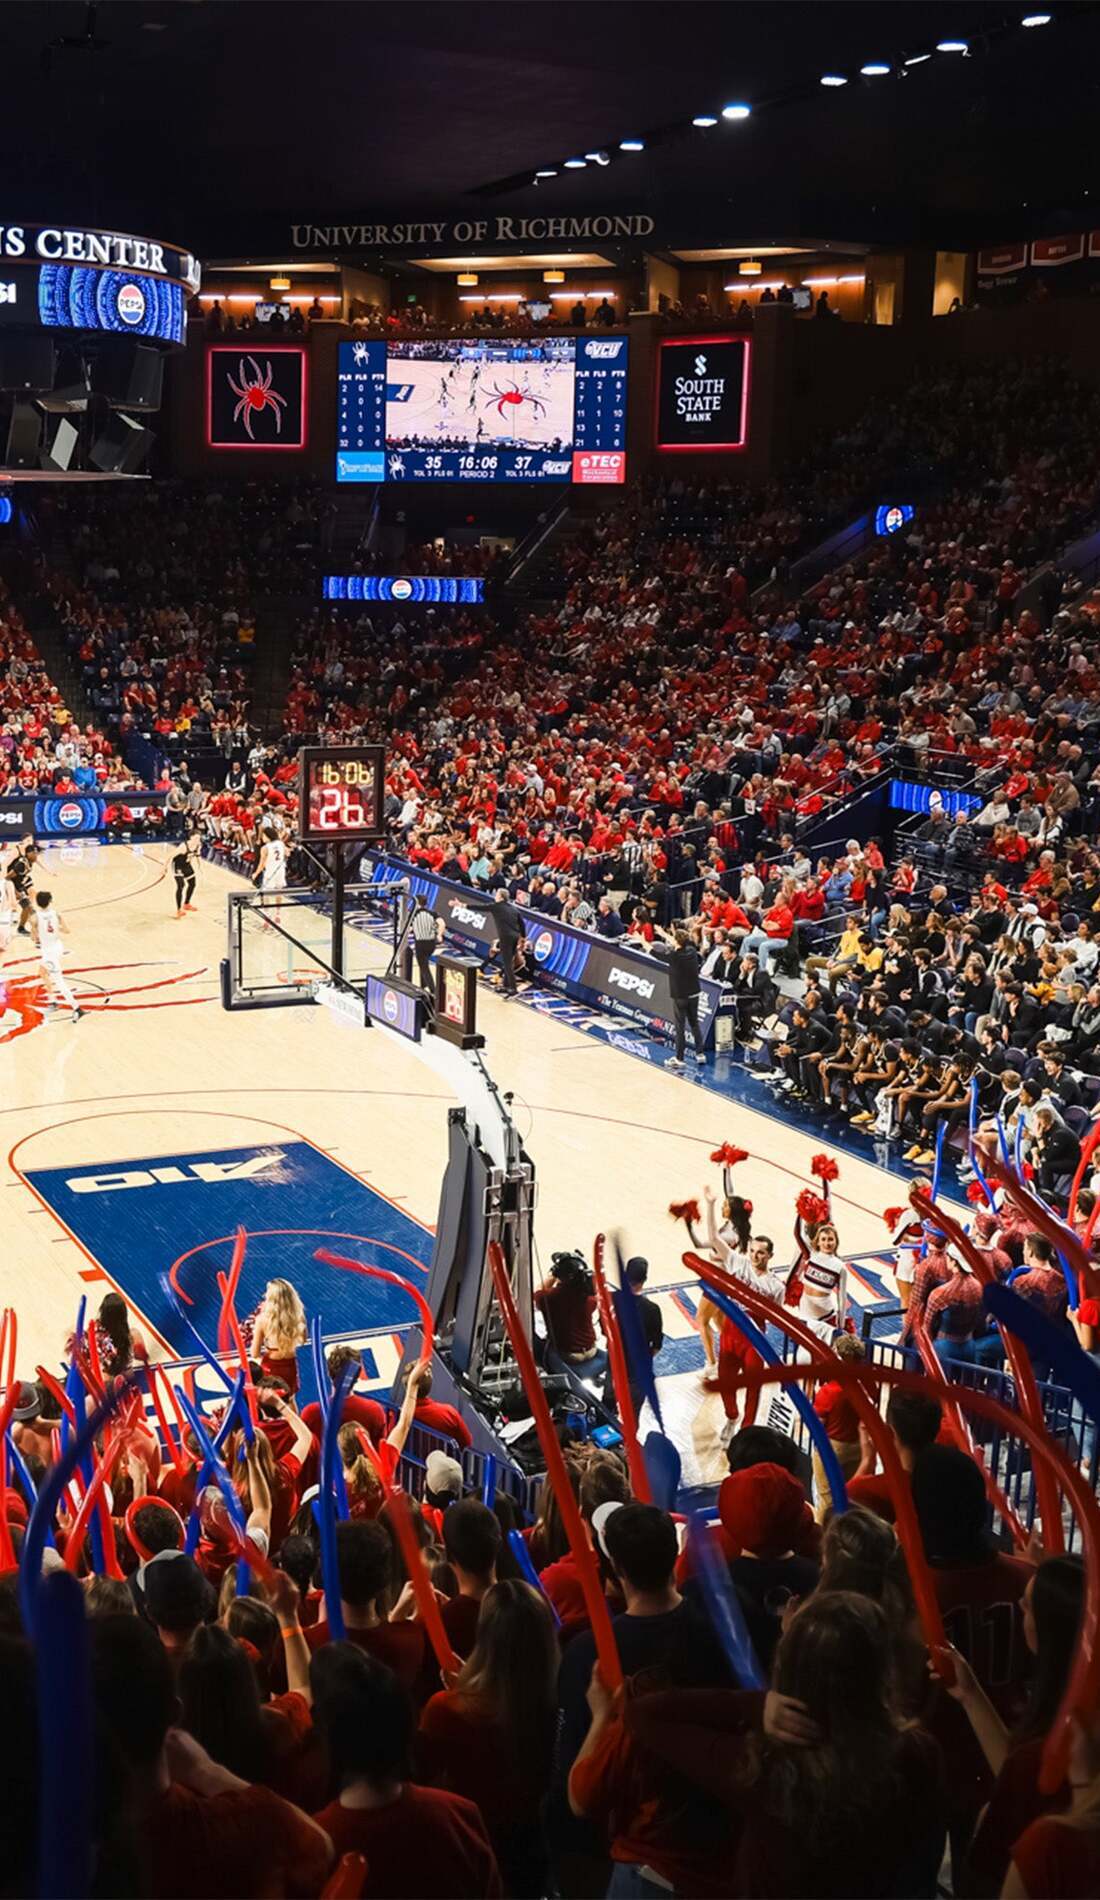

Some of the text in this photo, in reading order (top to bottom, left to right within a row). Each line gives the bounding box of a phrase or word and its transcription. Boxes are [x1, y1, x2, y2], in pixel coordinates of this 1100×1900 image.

[453, 222, 488, 242] OF
[0, 226, 168, 273] S CENTER
[342, 384, 347, 392] 2
[358, 384, 364, 392] 0
[580, 381, 584, 389] 2
[597, 381, 602, 389] 2
[358, 397, 364, 405] 0
[580, 394, 621, 403] 7 1 7
[614, 409, 623, 417] 10
[685, 413, 711, 422] BANK
[424, 456, 442, 469] 35
[458, 456, 498, 469] 16:06
[514, 456, 532, 469] 37
[580, 455, 621, 468] eTEC
[459, 470, 495, 478] PERIOD 2
[322, 761, 371, 784] 16:06
[319, 788, 365, 829] 26
[450, 905, 487, 930] PEPSI
[607, 966, 655, 999] PEPSI
